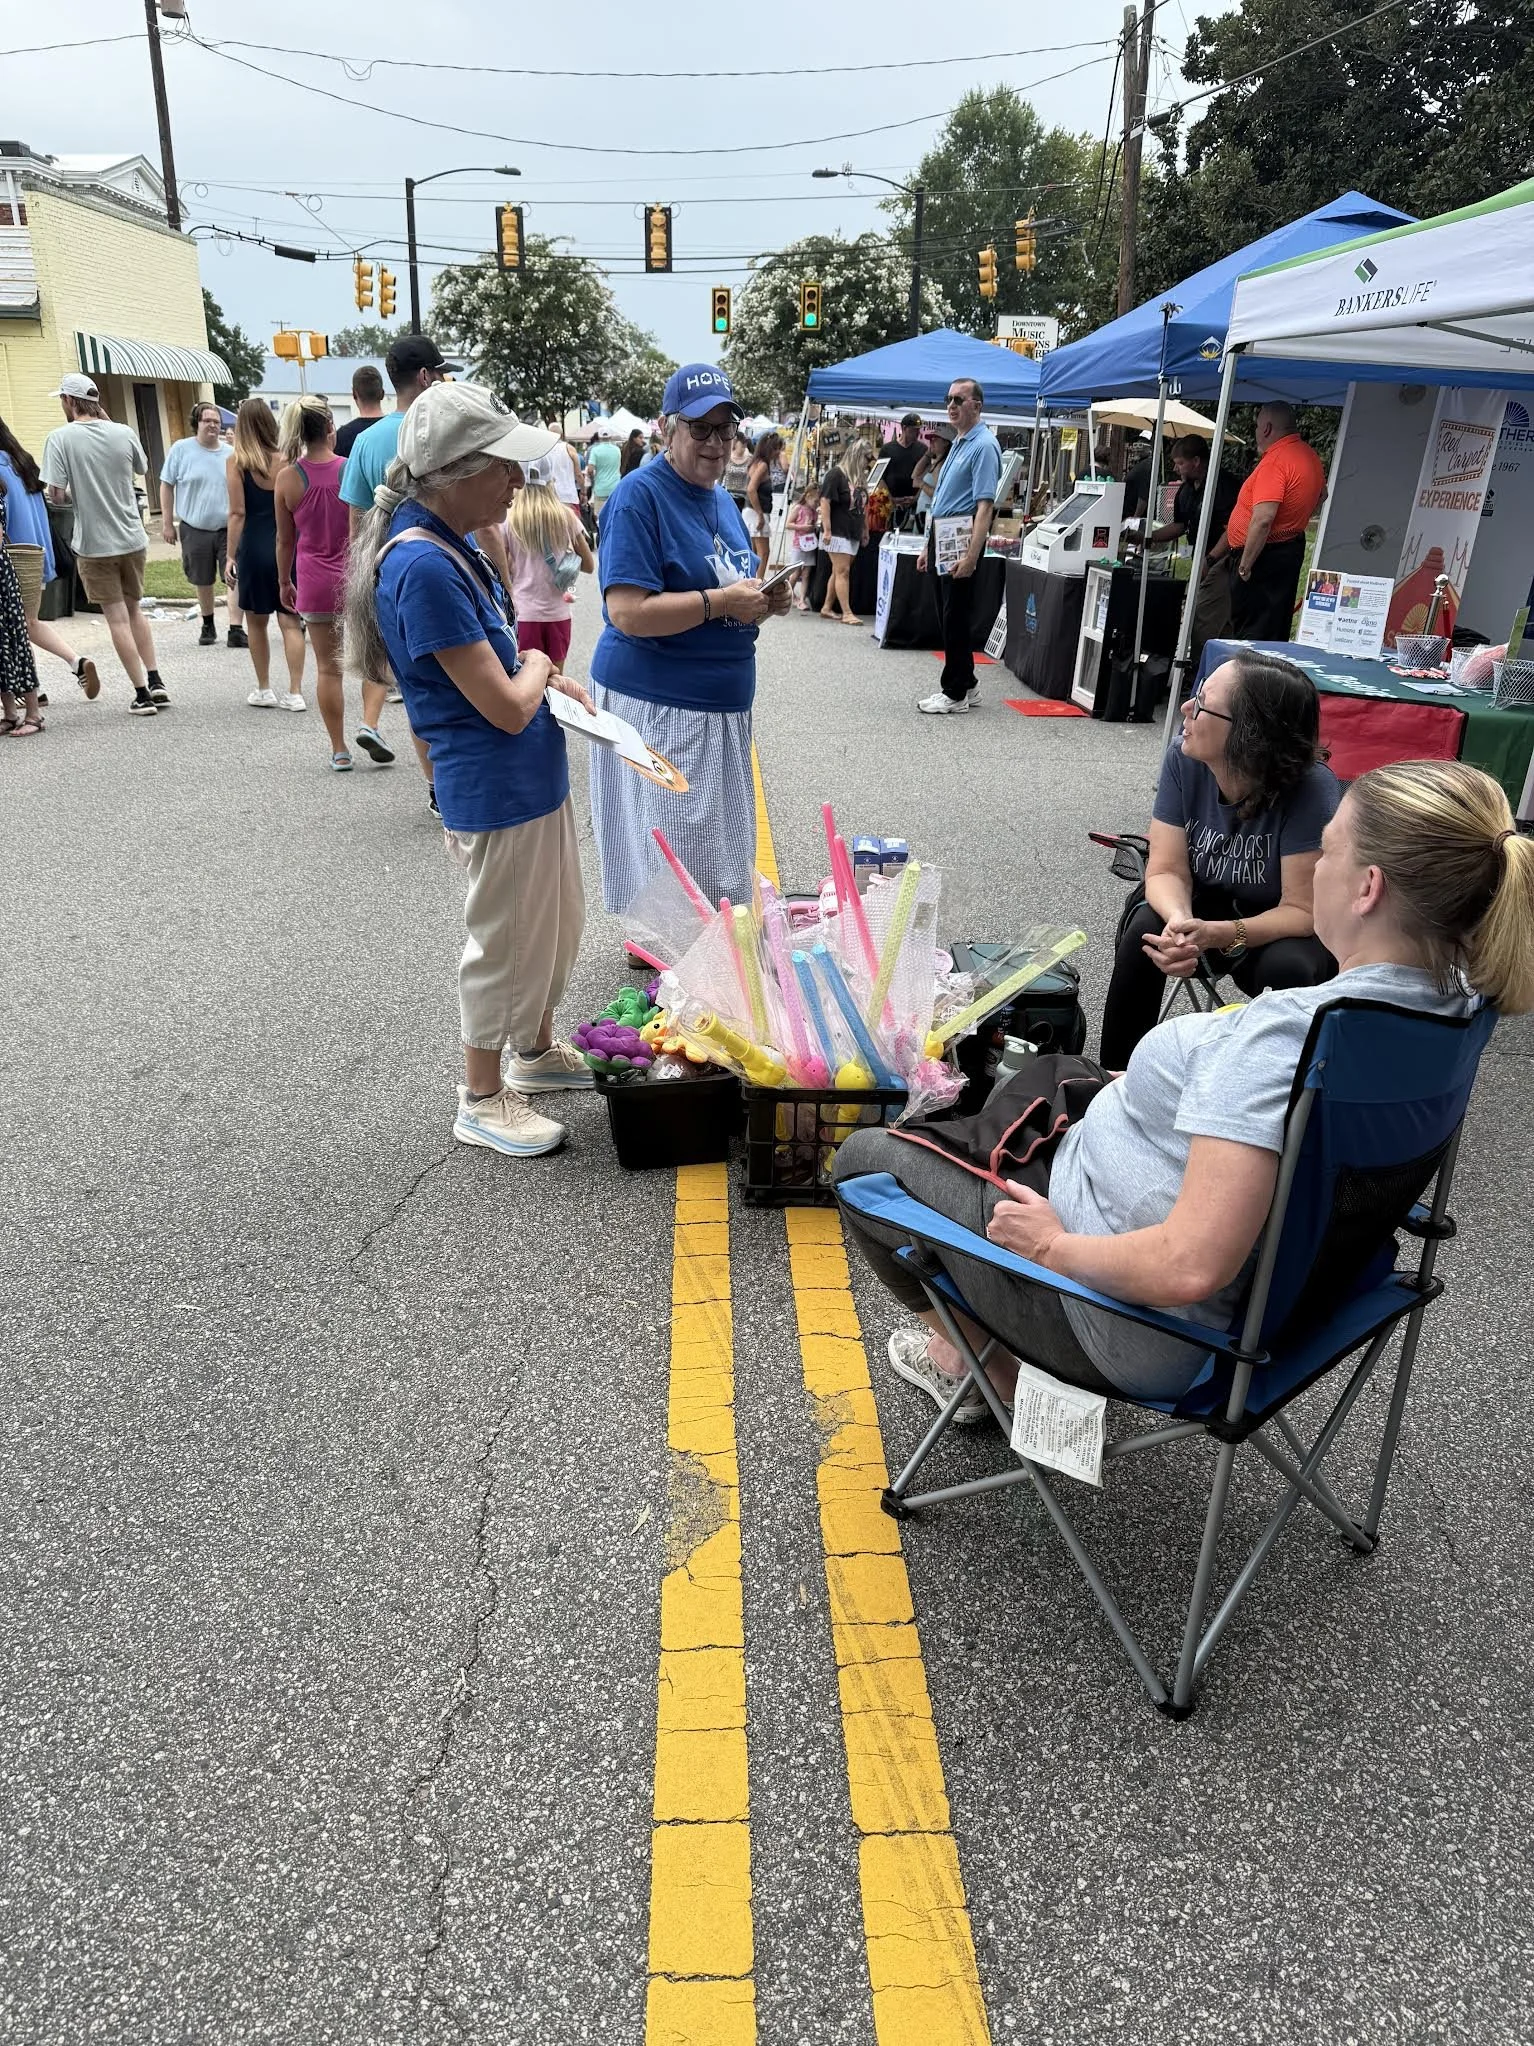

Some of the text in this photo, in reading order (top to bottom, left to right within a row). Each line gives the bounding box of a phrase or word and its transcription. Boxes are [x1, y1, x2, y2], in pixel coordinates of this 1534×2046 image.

[1334, 280, 1433, 316] BANKERSLIFE
[1012, 328, 1045, 339] MUSIC
[686, 372, 730, 391] HOPE
[1440, 430, 1465, 453] Red
[1447, 444, 1485, 473] Carpet
[1499, 462, 1521, 472] 1967
[1418, 489, 1482, 511] EXPERIENCE
[1206, 855, 1230, 881] MY
[1231, 860, 1267, 884] HAIR
